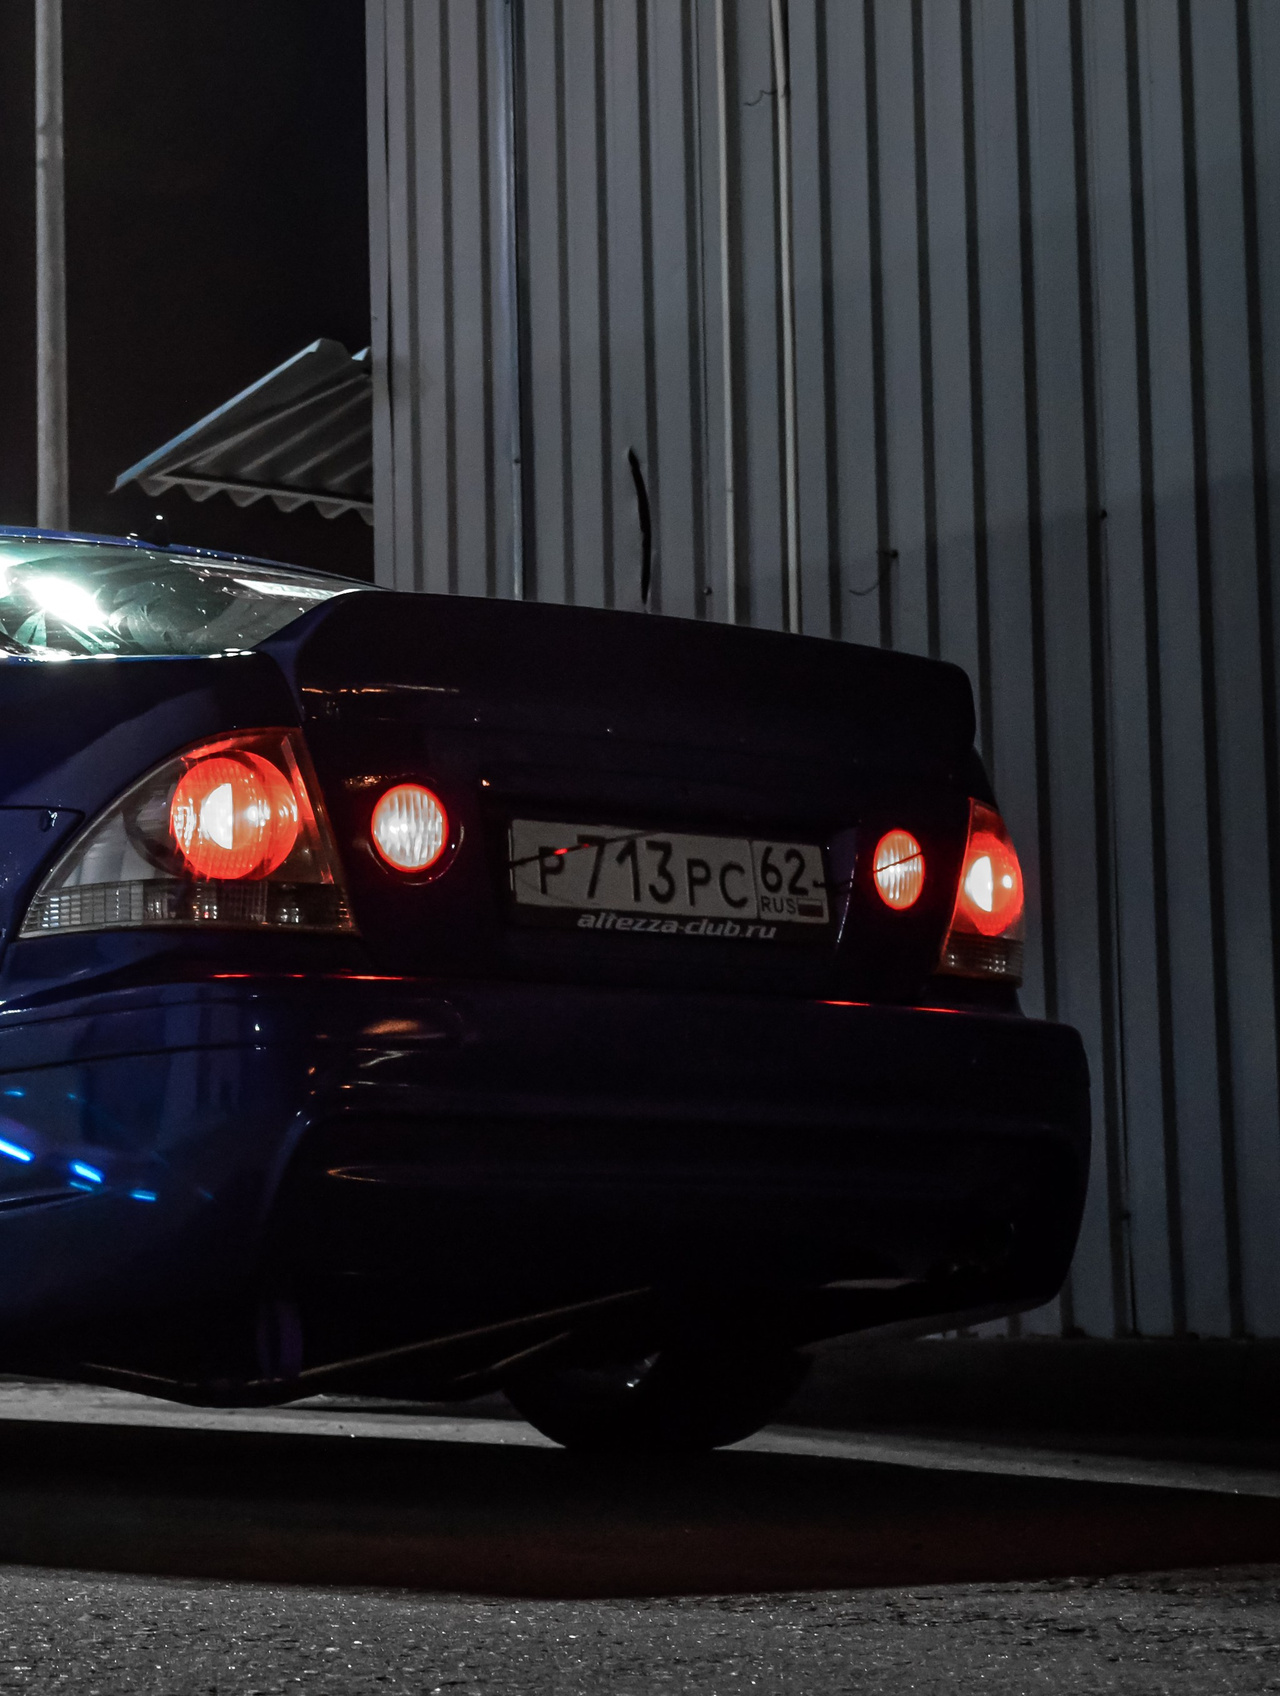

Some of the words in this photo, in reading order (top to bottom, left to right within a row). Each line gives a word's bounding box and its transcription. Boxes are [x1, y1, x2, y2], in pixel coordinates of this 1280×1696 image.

[760, 846, 809, 897] 62
[760, 897, 796, 914] RUS
[577, 912, 777, 940] altezza-club.ru
